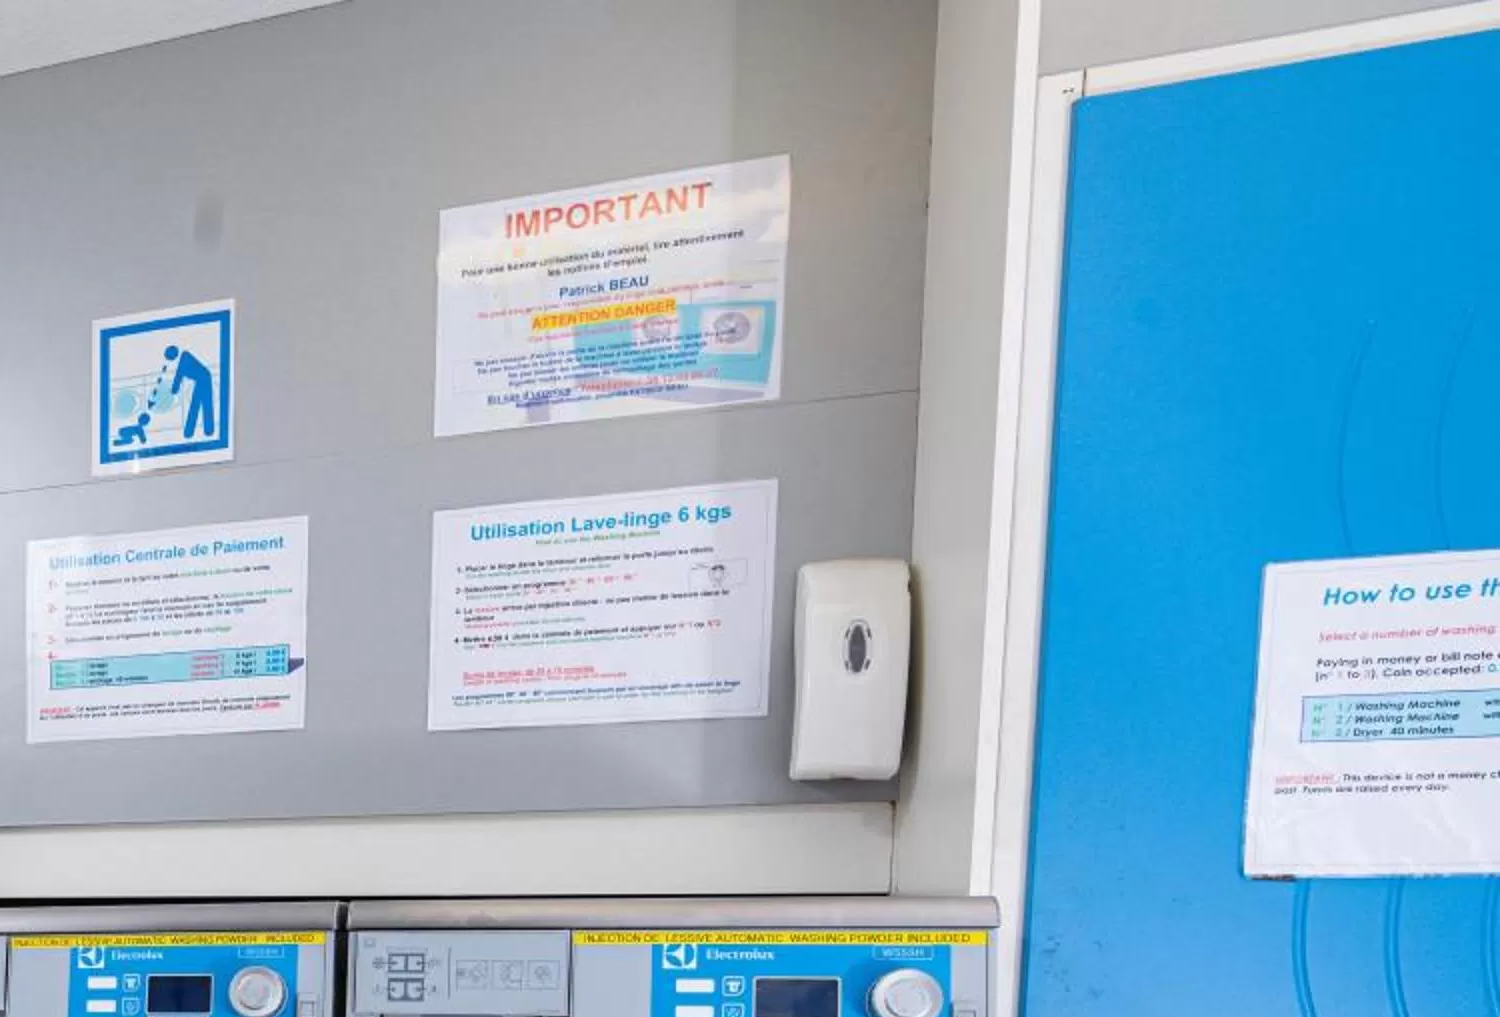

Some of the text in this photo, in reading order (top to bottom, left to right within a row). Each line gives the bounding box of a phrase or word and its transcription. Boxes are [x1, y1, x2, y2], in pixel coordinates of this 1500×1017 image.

[504, 181, 713, 240] IMPORTANT
[558, 276, 650, 298] Patrick BEAU
[532, 307, 611, 330] ATTENTION
[614, 298, 677, 319] DANGER
[470, 503, 733, 541] Utilisation Lave-linge 6 kgs
[50, 536, 285, 571] Utilisation Centrale de Paiement
[1323, 587, 1382, 607] How
[1389, 583, 1416, 604] to
[1426, 583, 1471, 600] use
[1371, 628, 1422, 640] number
[1425, 626, 1441, 637] of
[1441, 624, 1496, 637] washing
[1316, 650, 1495, 669] Paying in money or bill note
[1347, 669, 1361, 679] to
[1381, 667, 1412, 678] Coin
[1355, 700, 1404, 712] Washing
[1408, 699, 1462, 710] Machine
[1354, 713, 1403, 725] Washing
[1407, 712, 1461, 722] Machine
[1353, 727, 1384, 739] Dryer
[1407, 725, 1455, 735] minutes
[1416, 770, 1435, 780] not
[715, 933, 784, 943] AUTOMATIC
[790, 933, 847, 943] WASHING
[849, 933, 904, 943] POWDER
[907, 933, 971, 943] INCLUDED
[111, 949, 164, 961] Electrolux
[705, 948, 775, 960] Electrolux
